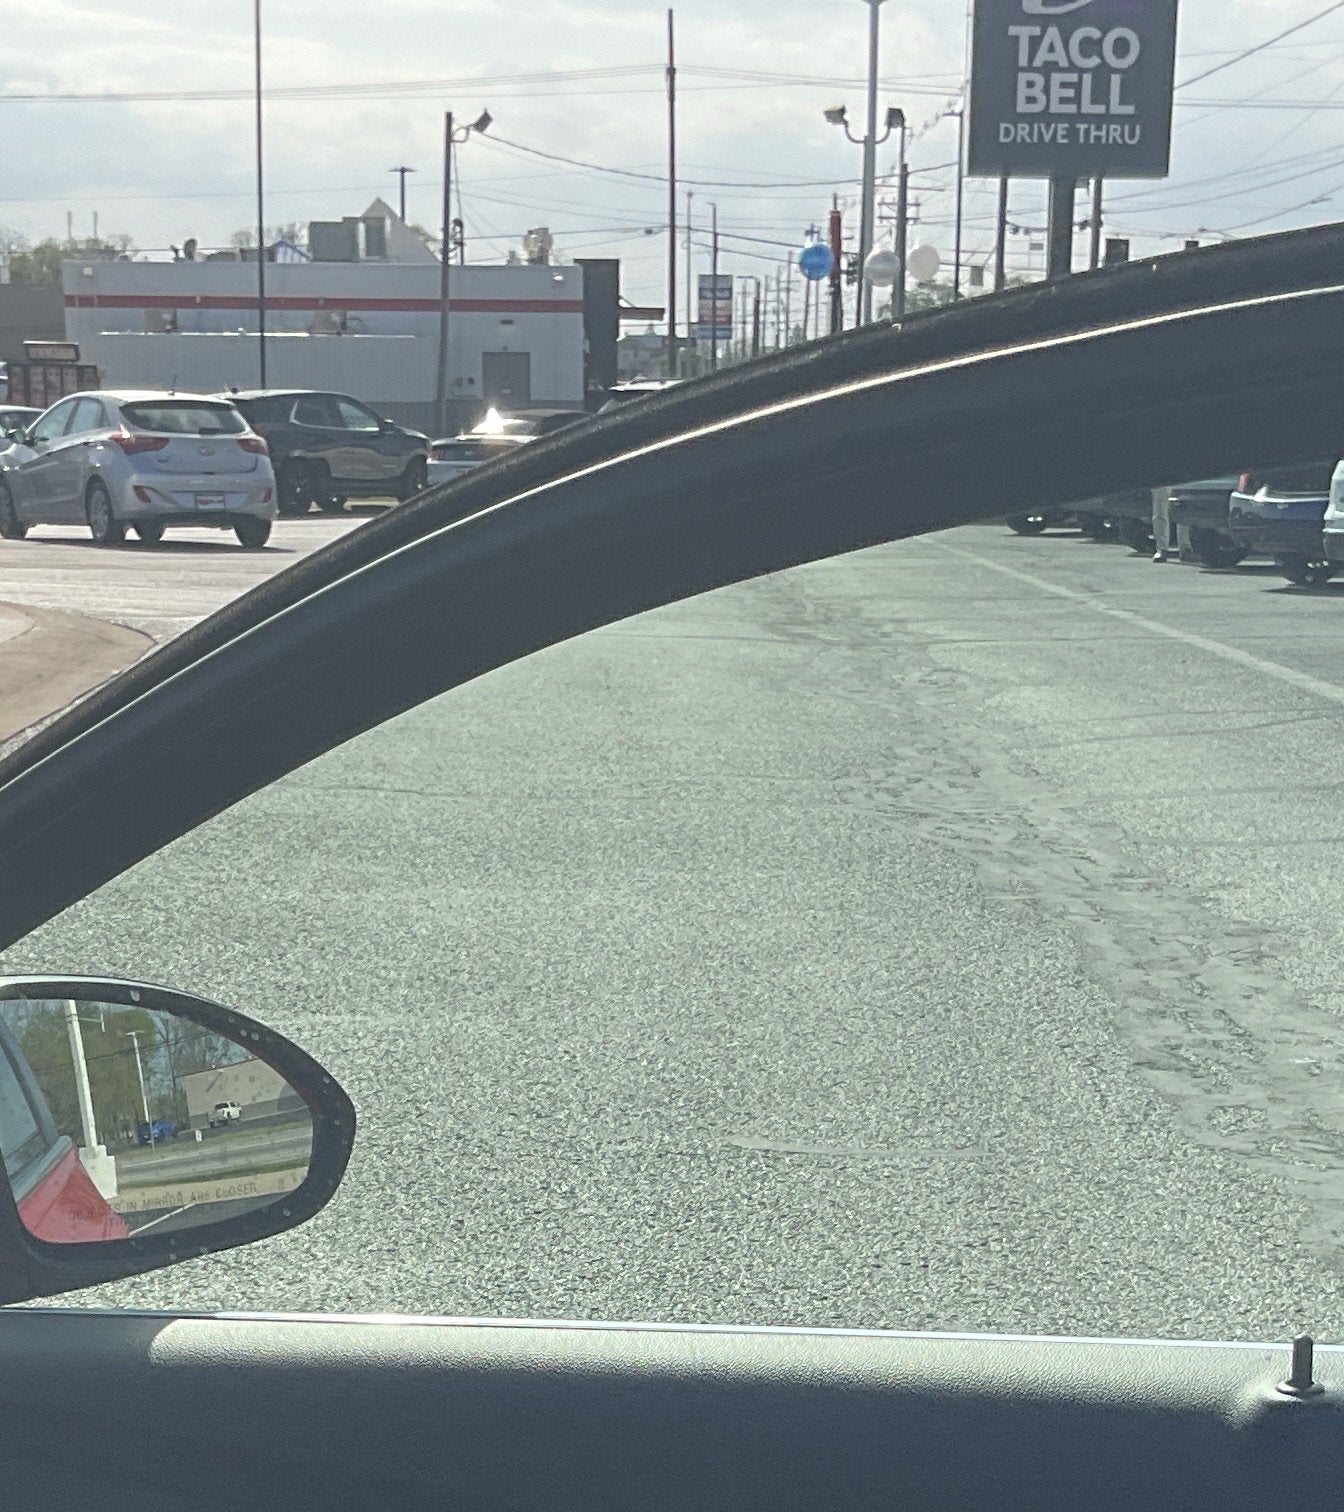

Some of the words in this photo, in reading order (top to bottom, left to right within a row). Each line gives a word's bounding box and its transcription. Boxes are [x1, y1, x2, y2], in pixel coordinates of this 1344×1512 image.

[1007, 25, 1141, 69] TACO
[1016, 72, 1136, 115] BELL
[999, 123, 1070, 144] DRIVE
[1076, 123, 1141, 145] THRU
